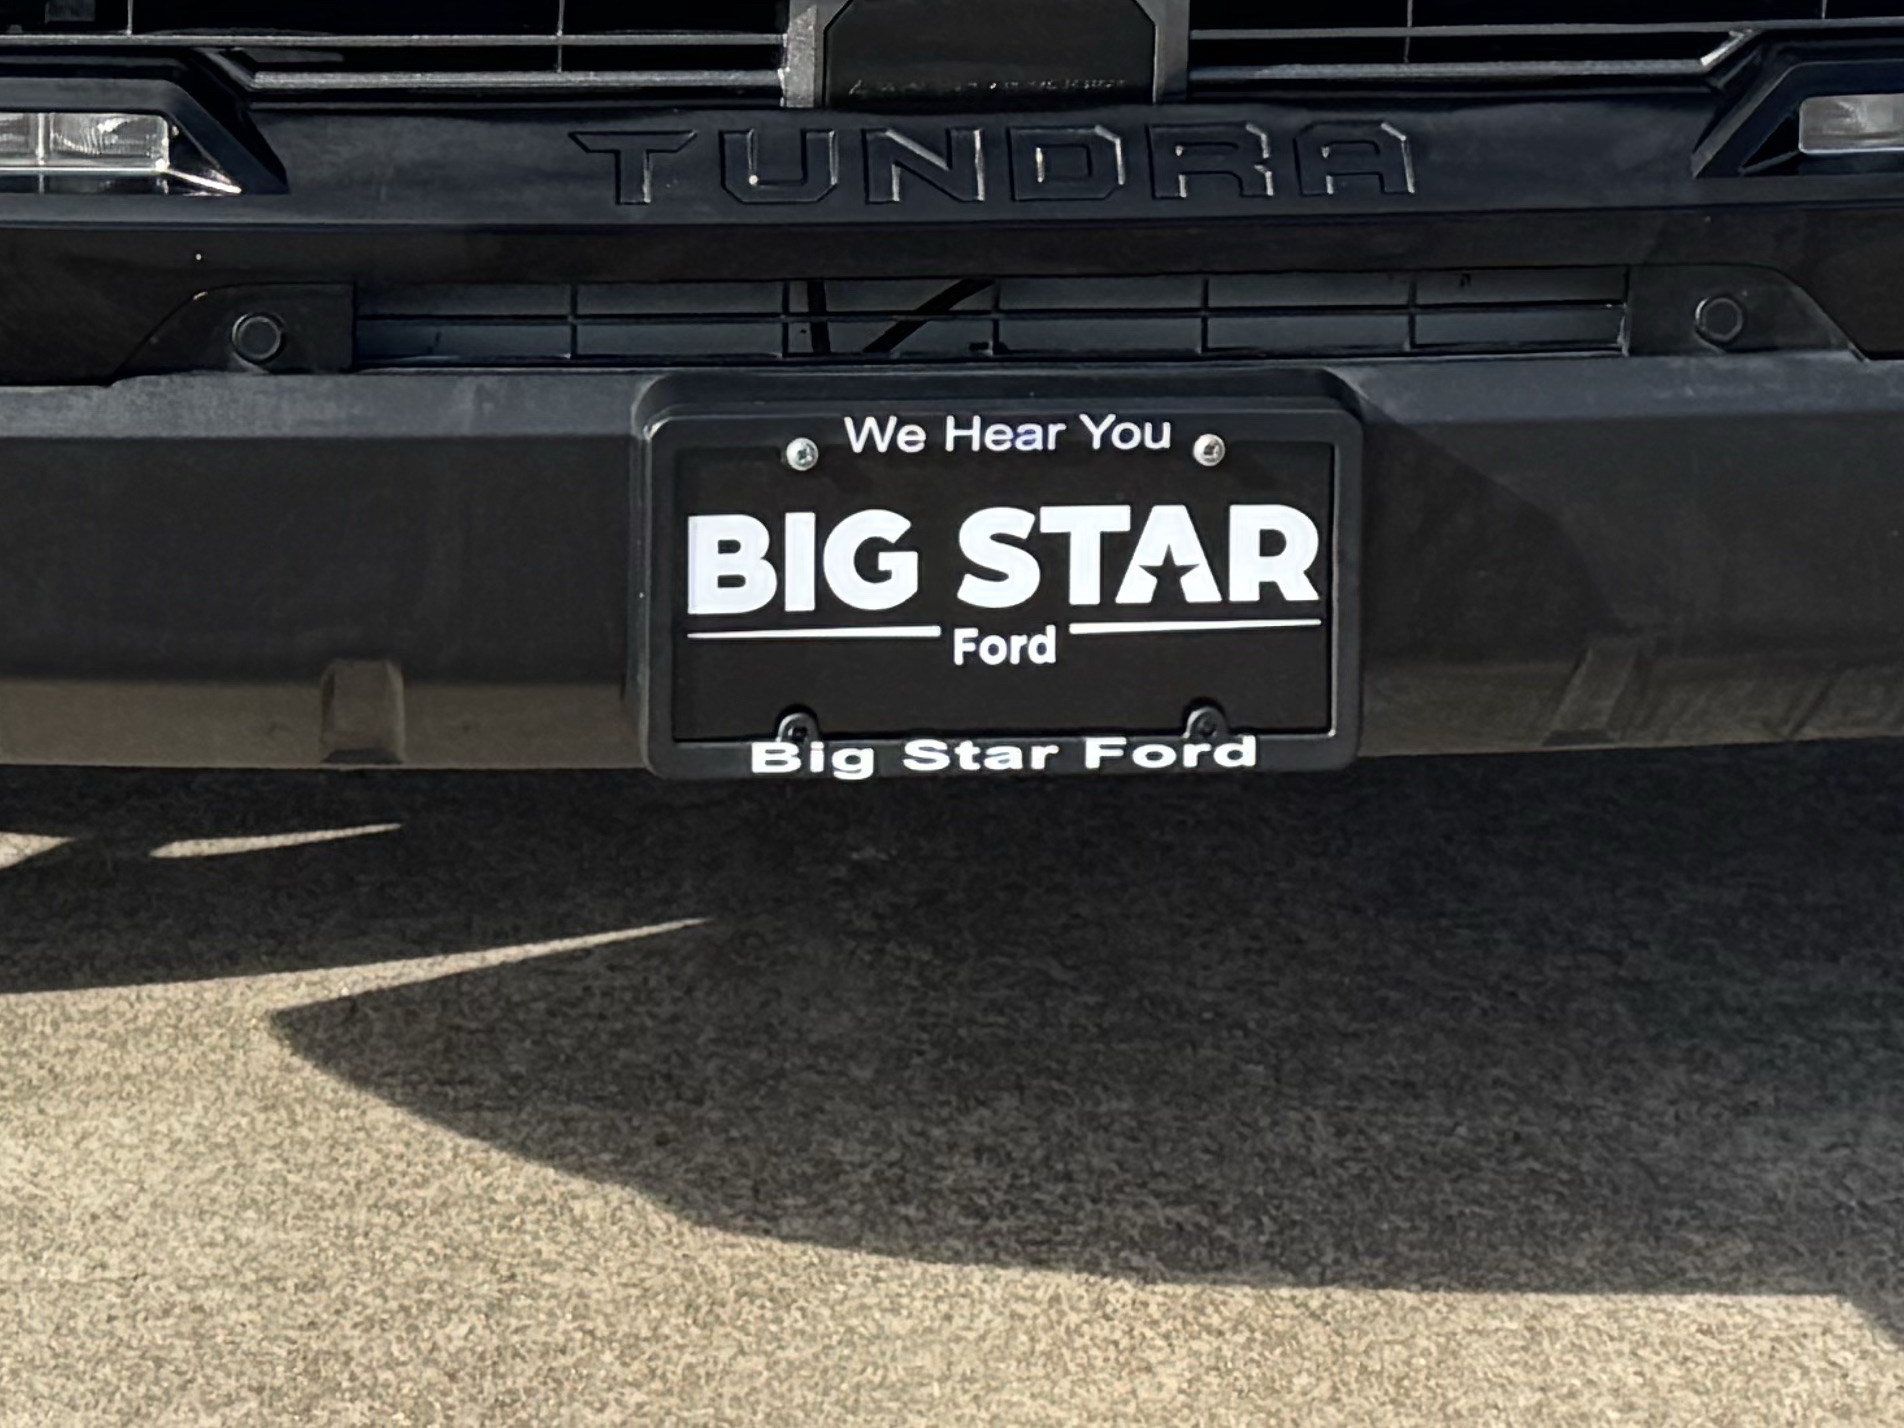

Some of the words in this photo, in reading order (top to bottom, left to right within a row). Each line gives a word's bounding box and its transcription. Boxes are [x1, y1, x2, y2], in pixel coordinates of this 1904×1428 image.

[568, 122, 1415, 205] TUNDRA
[843, 415, 927, 454] We
[944, 414, 1067, 452] Hear
[1078, 413, 1171, 451] You
[687, 509, 919, 615] BIG
[956, 504, 1320, 609] STAR
[953, 624, 1057, 666] Ford
[749, 741, 875, 781] Big
[902, 738, 1060, 772] Star
[1082, 734, 1257, 770] Ford
